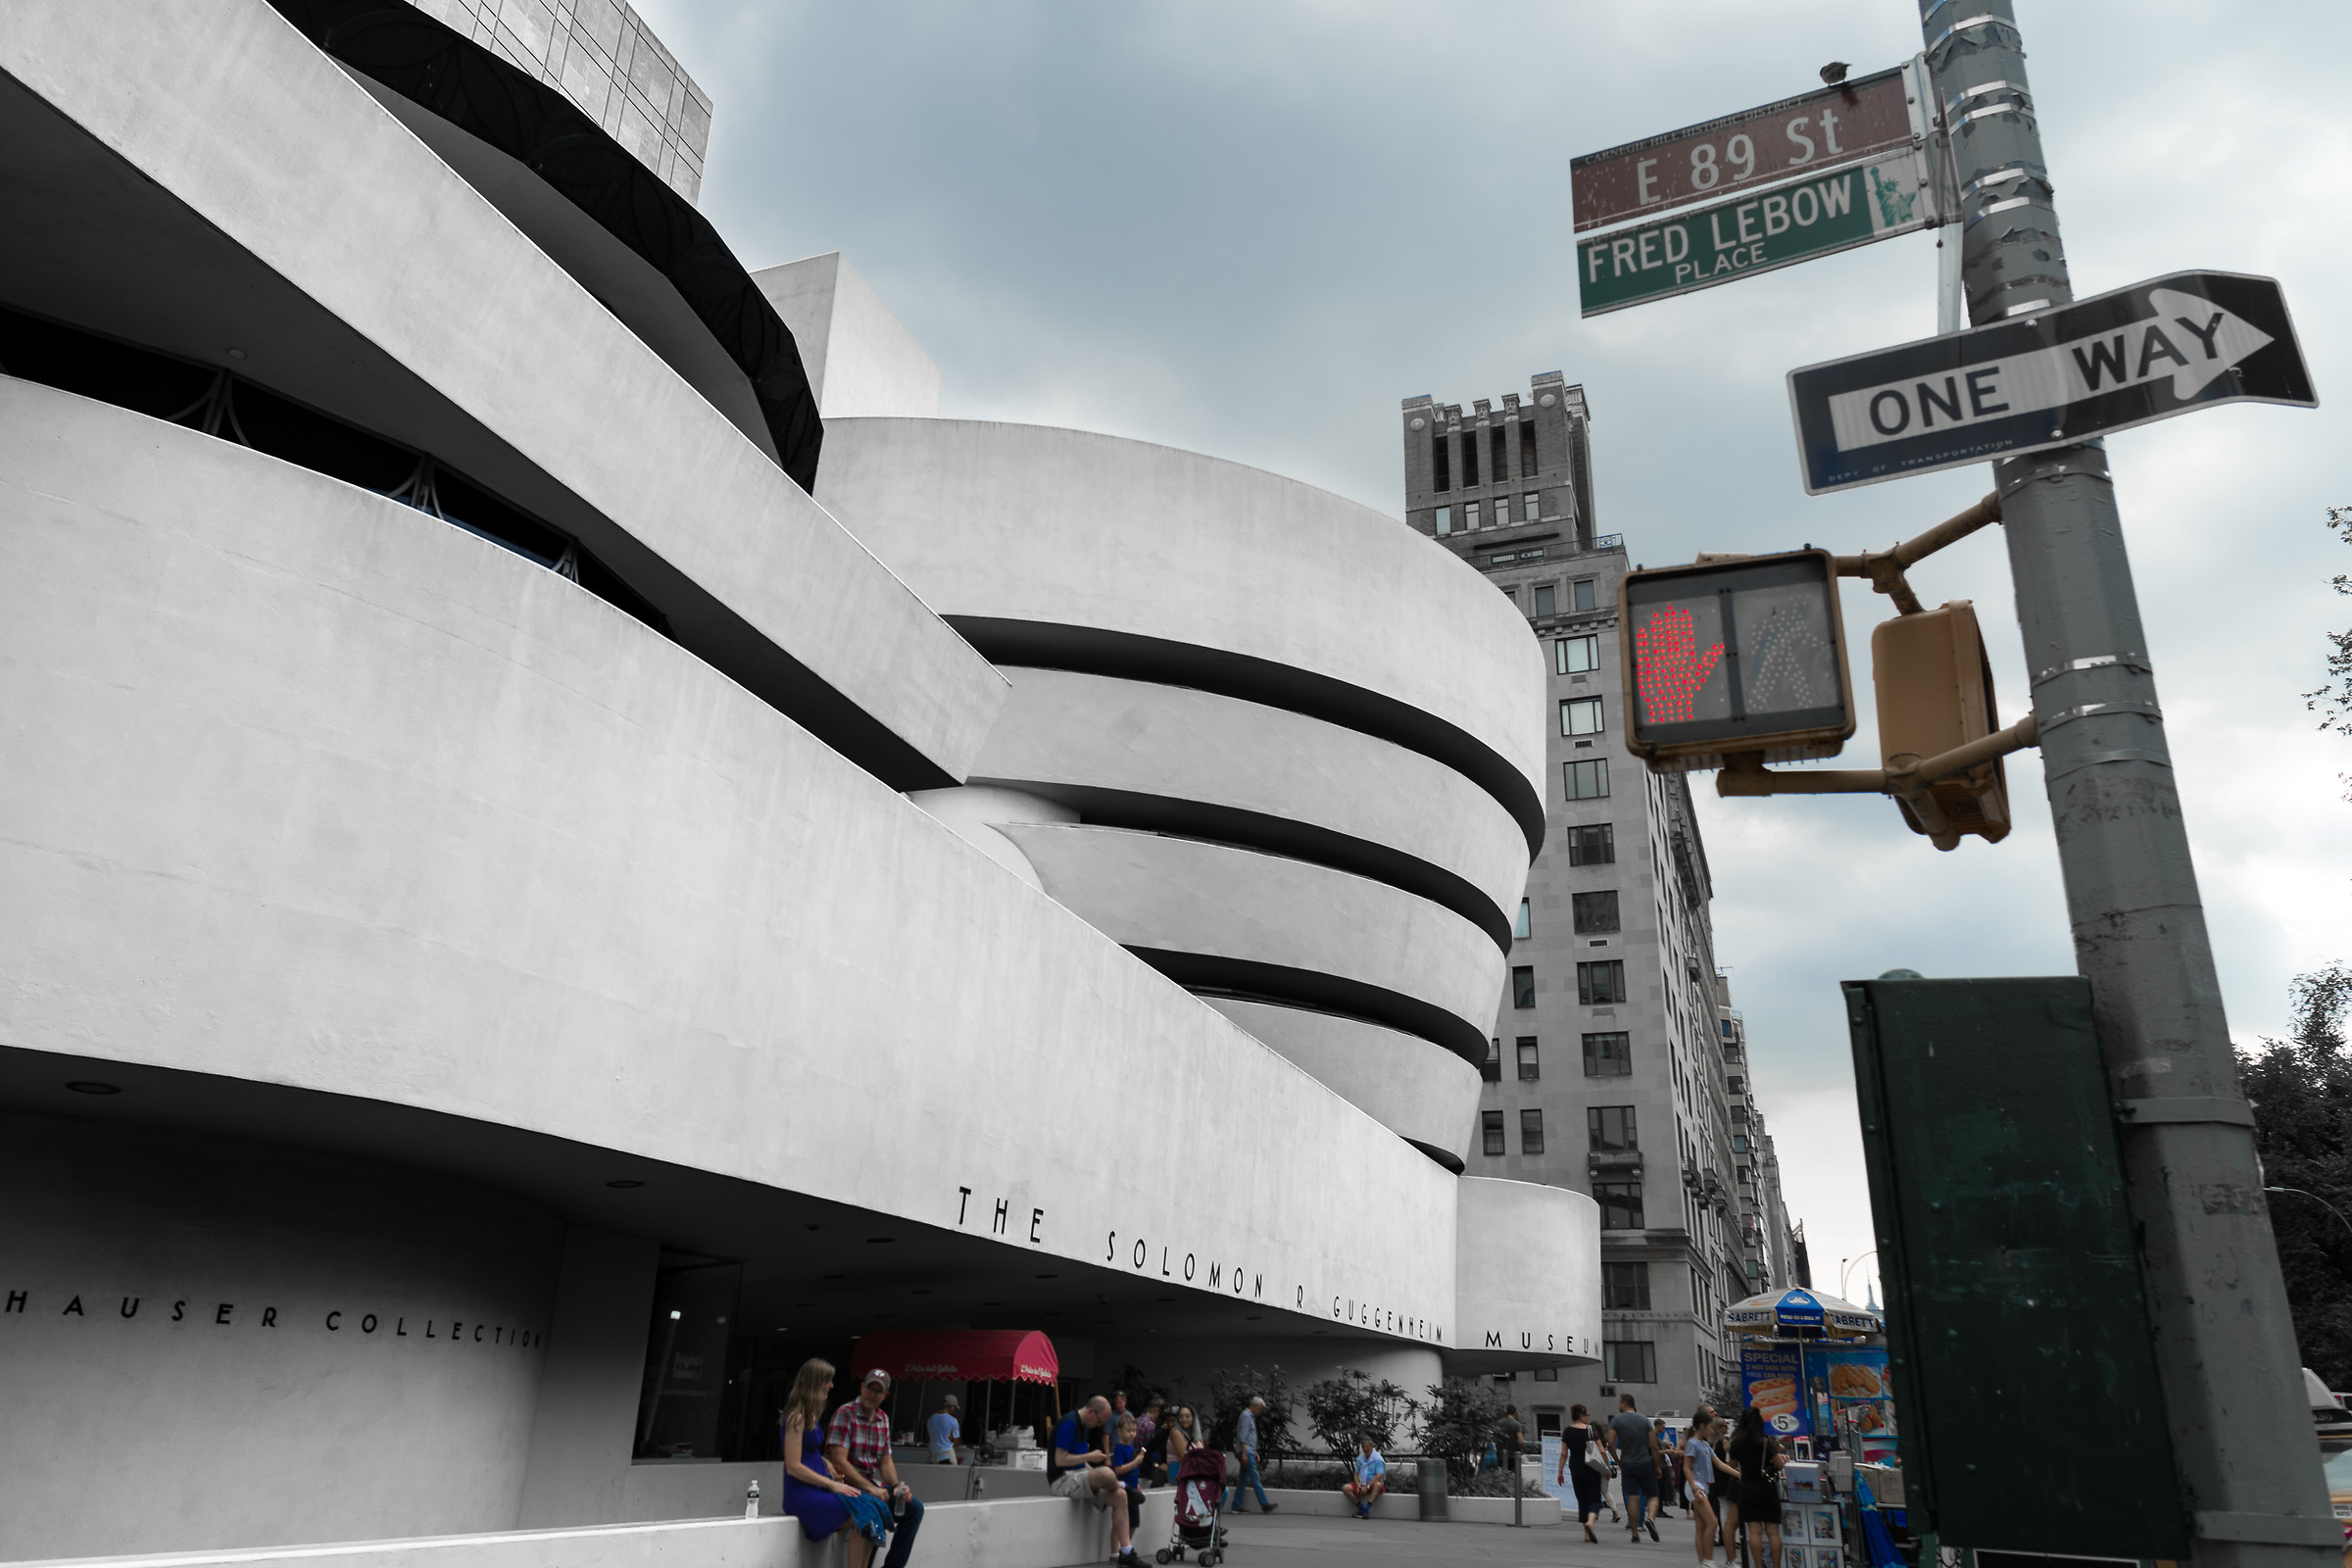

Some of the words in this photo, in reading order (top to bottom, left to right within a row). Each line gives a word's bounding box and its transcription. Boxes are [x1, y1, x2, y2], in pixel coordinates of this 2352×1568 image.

[1585, 140, 1647, 165] CARNEGIE
[1650, 132, 1679, 147] HILL
[1682, 115, 1740, 137] HISTORIC
[1744, 97, 1802, 121] DISTRICT
[1637, 159, 1660, 206] E
[1690, 134, 1755, 191] 89
[1786, 109, 1843, 165] St
[1588, 224, 1690, 283] FRED
[1711, 175, 1851, 251] LEBOW
[1675, 242, 1767, 283] PLACE
[1869, 367, 2010, 436] ONE
[2072, 312, 2225, 392] WAY
[1829, 470, 1859, 482] DEPT
[1873, 465, 1887, 473] OF
[1901, 439, 2013, 467] TRANSPORTATION
[958, 1186, 1045, 1244] THE
[1106, 1231, 1262, 1298] SOLOMON
[1297, 1285, 1304, 1309] R
[1333, 1296, 1443, 1344] GUGGENHEIM
[5, 1290, 278, 1329] HAUSER
[325, 1310, 540, 1349] COLLECTION
[1728, 1310, 1772, 1323] SABRETT
[1743, 1352, 1800, 1364] SPECIAL
